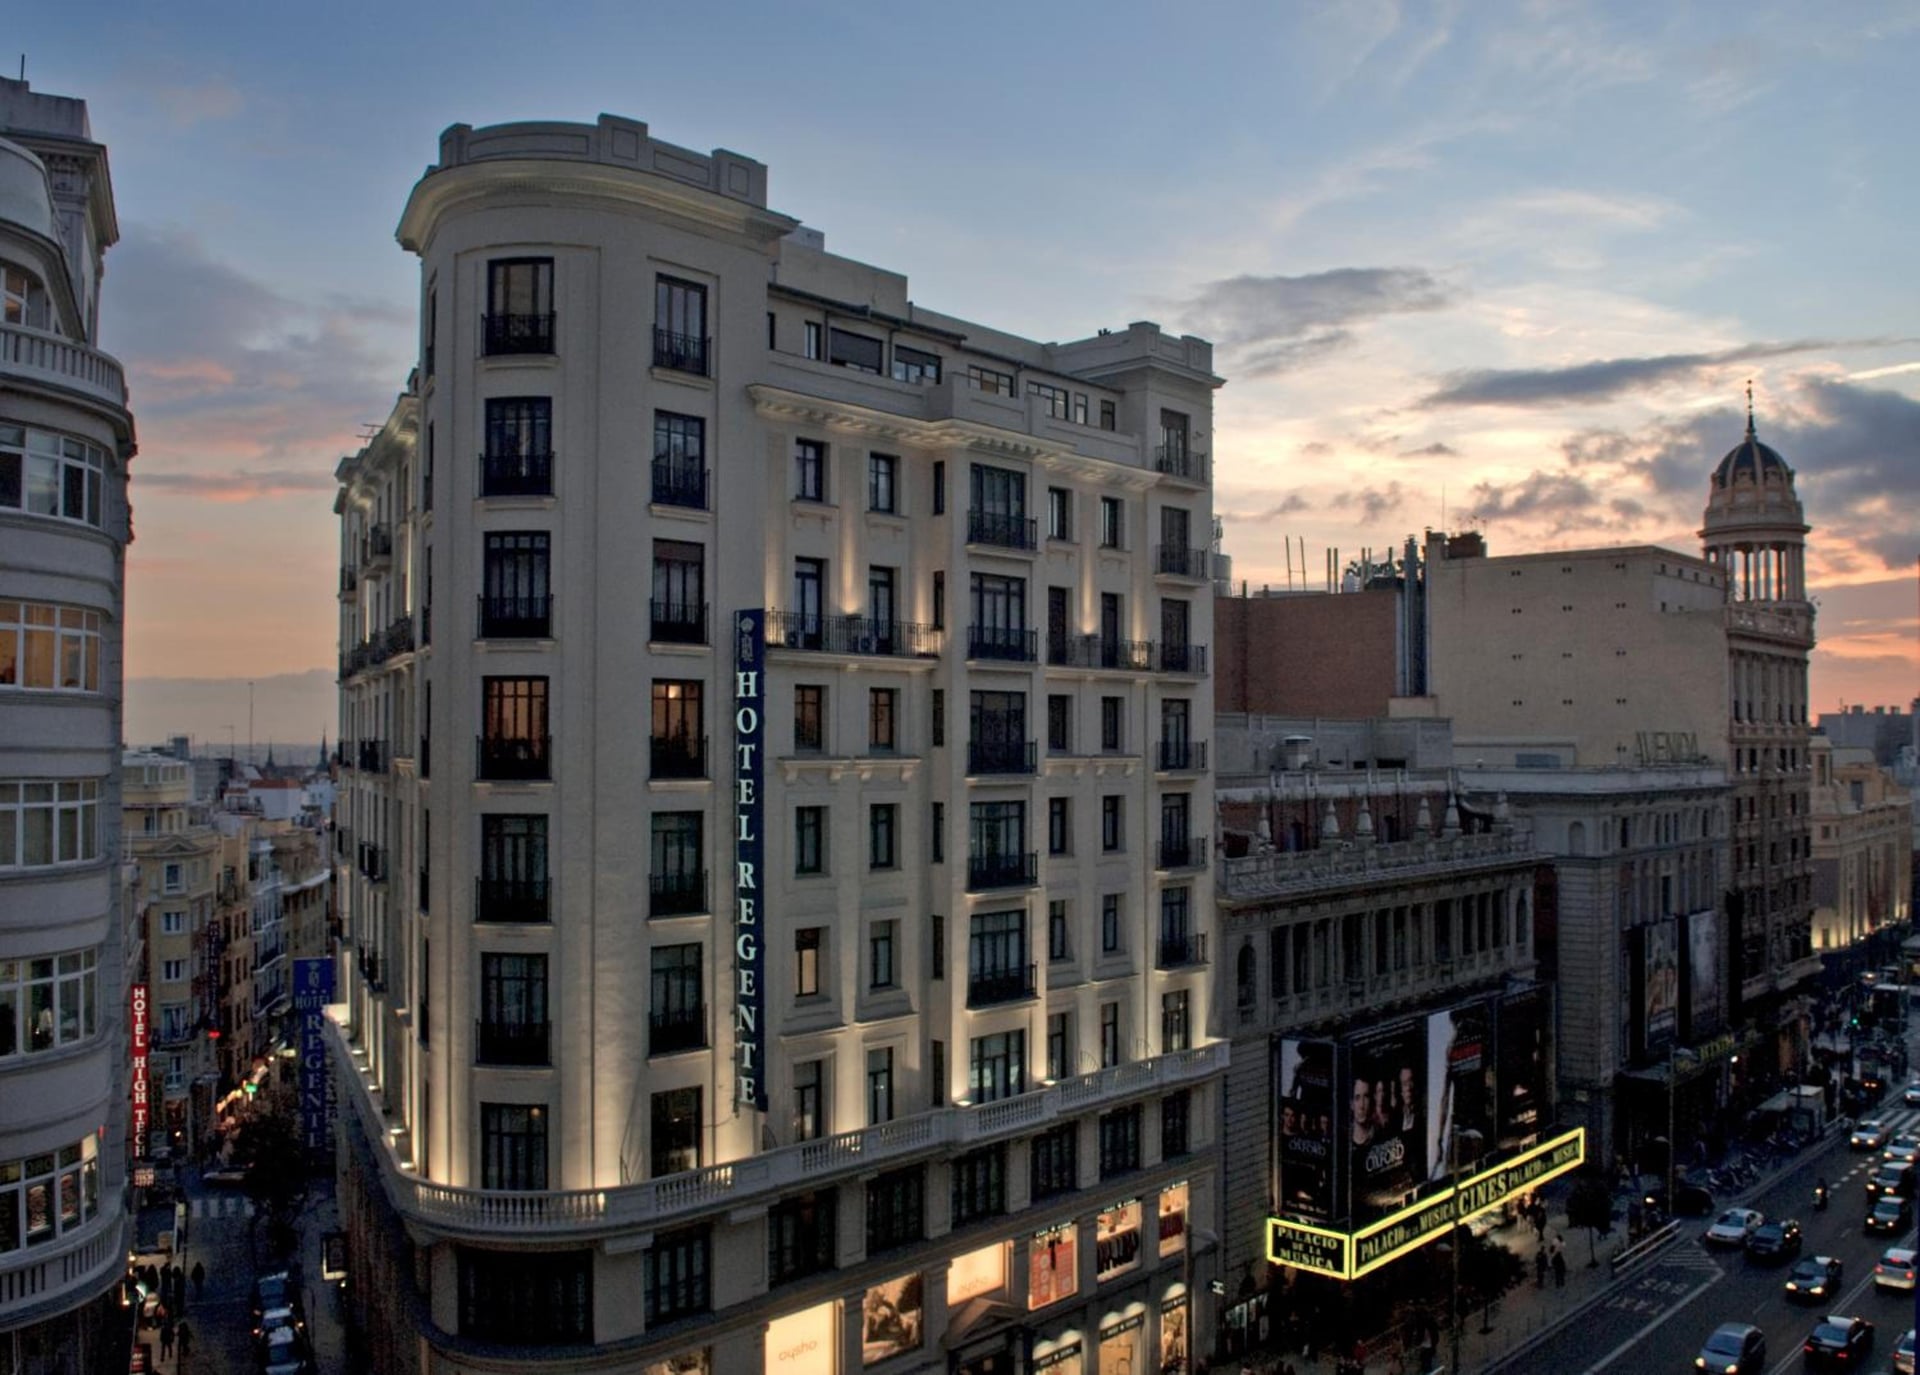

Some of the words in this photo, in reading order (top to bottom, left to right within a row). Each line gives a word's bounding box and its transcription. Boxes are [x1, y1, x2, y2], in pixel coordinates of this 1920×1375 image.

[735, 670, 757, 842] HOTEL
[735, 861, 757, 1105] REGENTE
[133, 988, 146, 1048] HOTEL
[133, 1056, 146, 1104] HIGH
[304, 1013, 322, 1149] REGENTE
[133, 1109, 146, 1159] TECH
[1277, 1226, 1338, 1250] PALACIO
[1360, 1224, 1405, 1262] PALACIO
[1419, 1201, 1455, 1232] MUSICA
[1458, 1172, 1507, 1216] CINES
[1279, 1247, 1334, 1271] MUSICA
[1291, 1241, 1304, 1252] DE
[1308, 1244, 1322, 1257] LA
[778, 1338, 819, 1362] oysho
